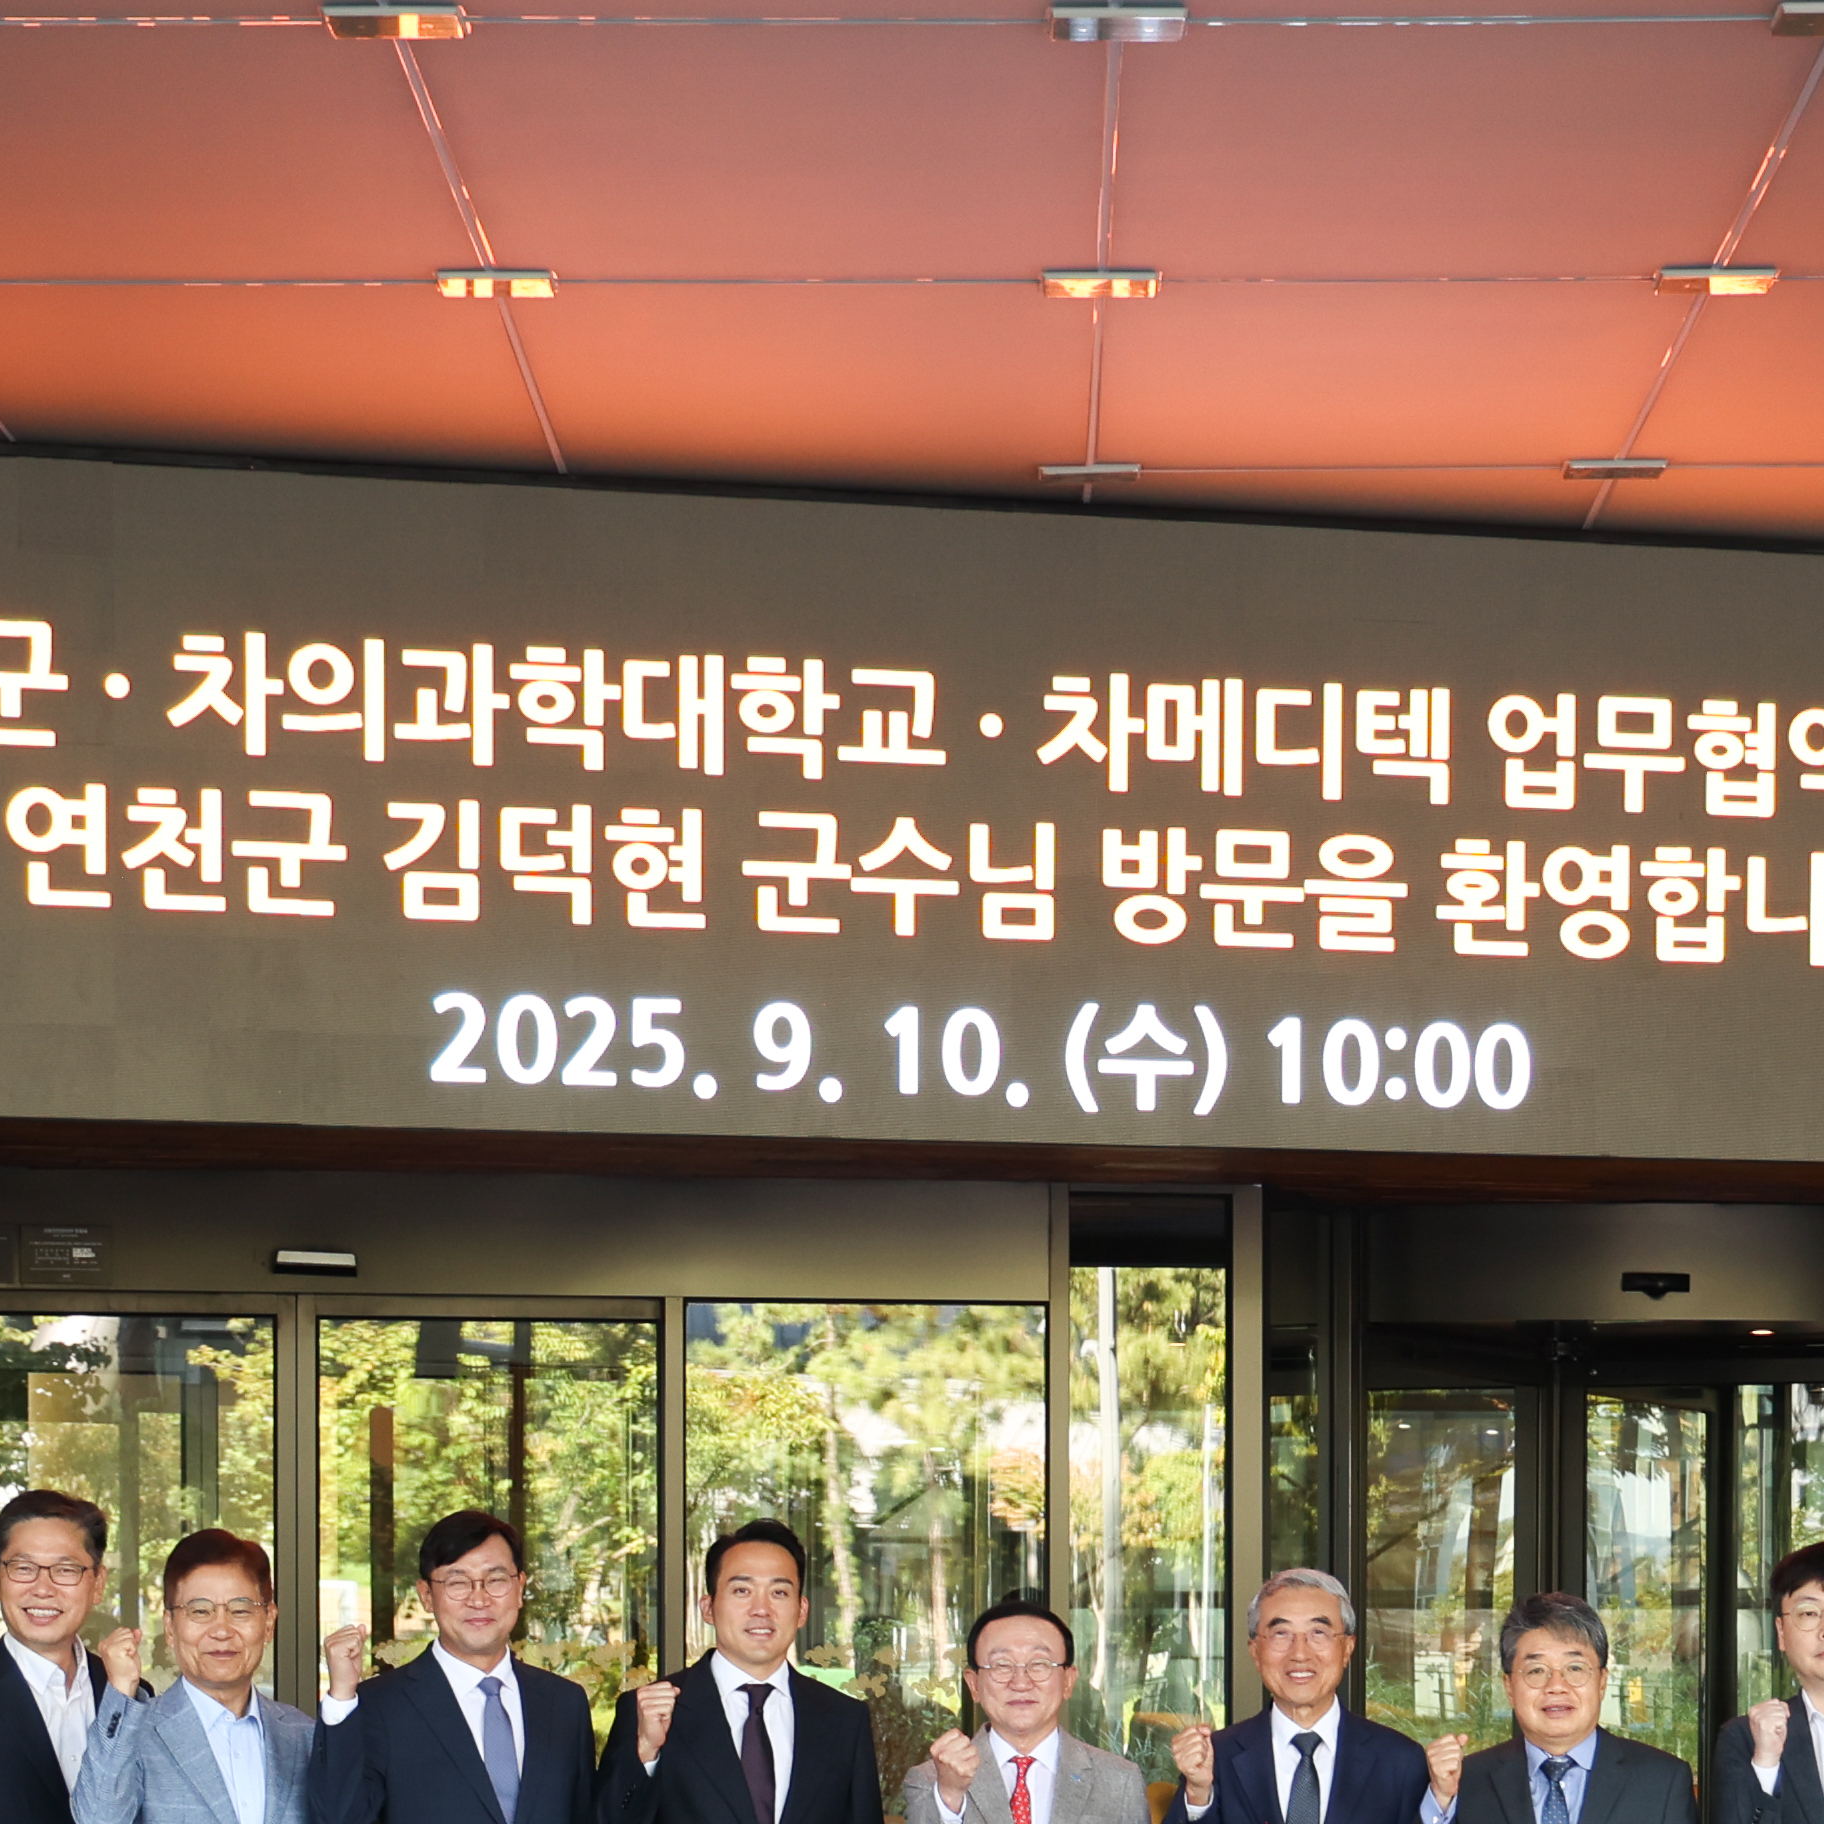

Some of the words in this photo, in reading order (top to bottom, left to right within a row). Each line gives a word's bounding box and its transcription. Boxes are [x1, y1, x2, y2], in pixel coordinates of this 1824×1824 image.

[167, 631, 946, 779] 차의과학대학교
[1037, 673, 1450, 805] 차메디텍
[6, 783, 347, 916] 연천군
[384, 799, 706, 929] 김덕현
[742, 811, 1055, 940] 군수님
[1103, 827, 1408, 952] 방문을
[430, 991, 717, 1099] 2025.
[753, 1001, 842, 1103] 9.
[884, 1005, 1029, 1107] 10.
[1065, 1002, 1228, 1116] (수)
[1268, 1017, 1531, 1110] 10:00
